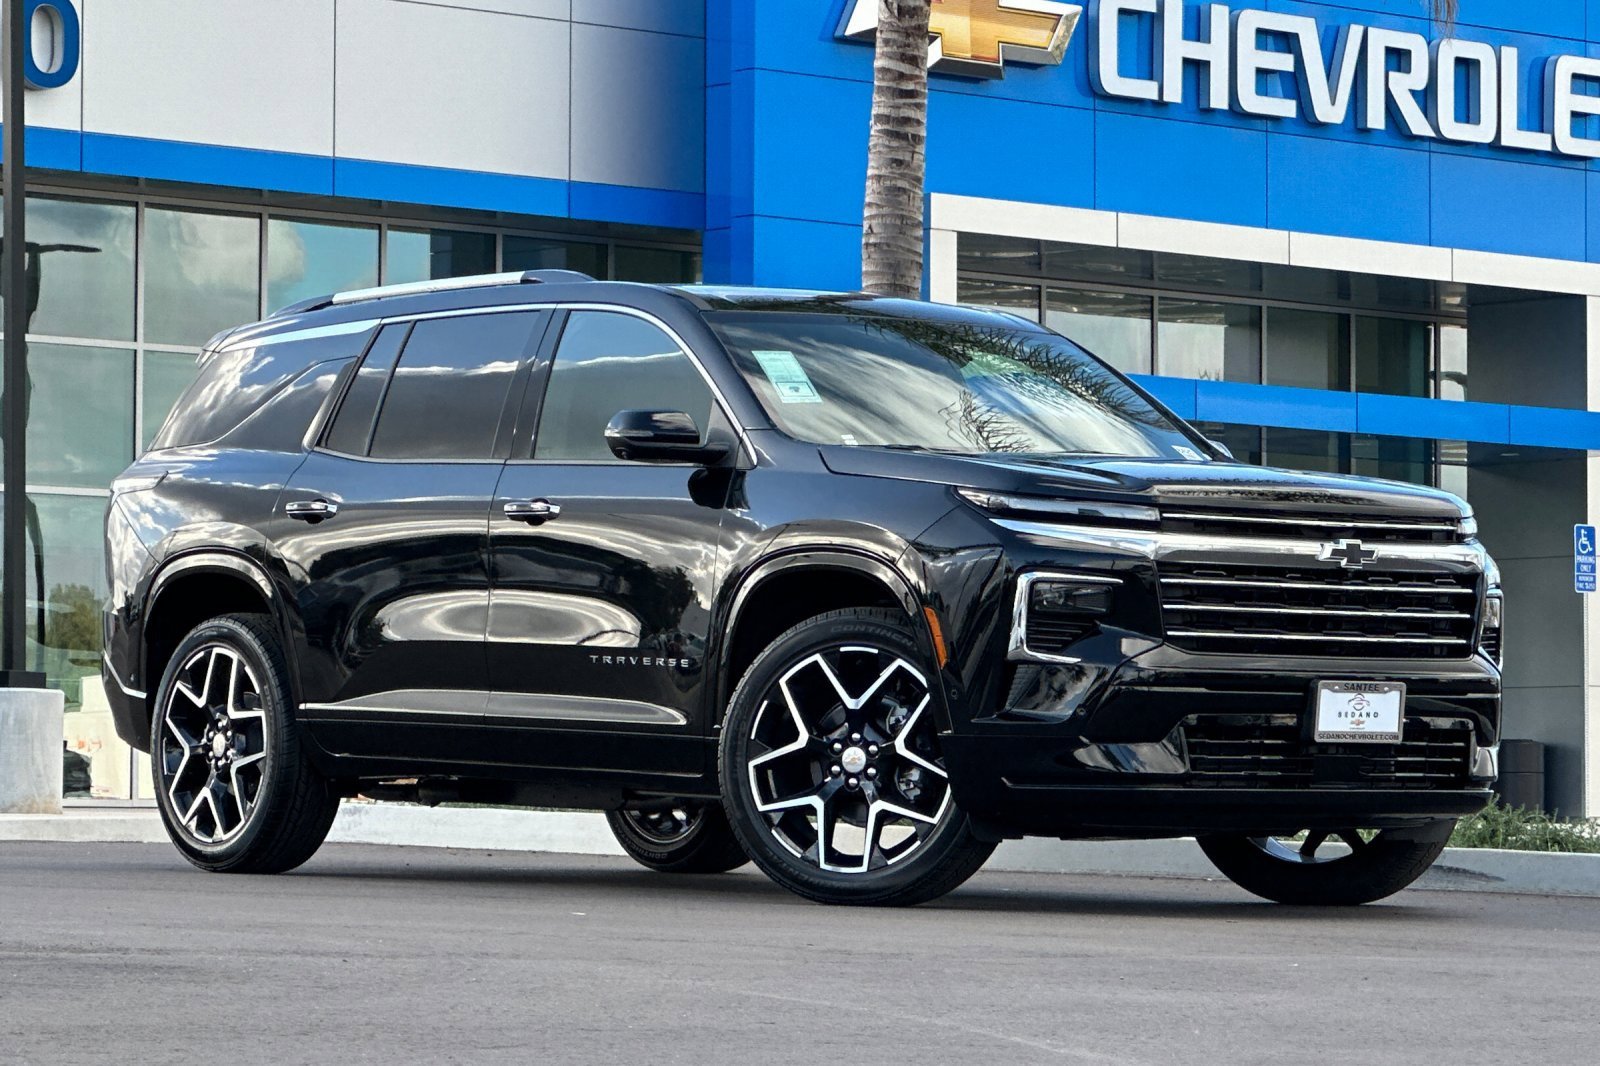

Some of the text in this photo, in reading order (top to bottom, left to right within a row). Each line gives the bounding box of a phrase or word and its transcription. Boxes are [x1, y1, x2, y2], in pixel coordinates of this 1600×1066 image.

[1093, 0, 1600, 158] CHEVROLE
[831, 624, 913, 647] CONTINEN
[589, 655, 689, 668] TRAVERSE
[1343, 683, 1380, 692] SANTEE
[1337, 711, 1379, 719] SEDANO
[1318, 732, 1399, 741] SEDANOCHEVROLET.COM
